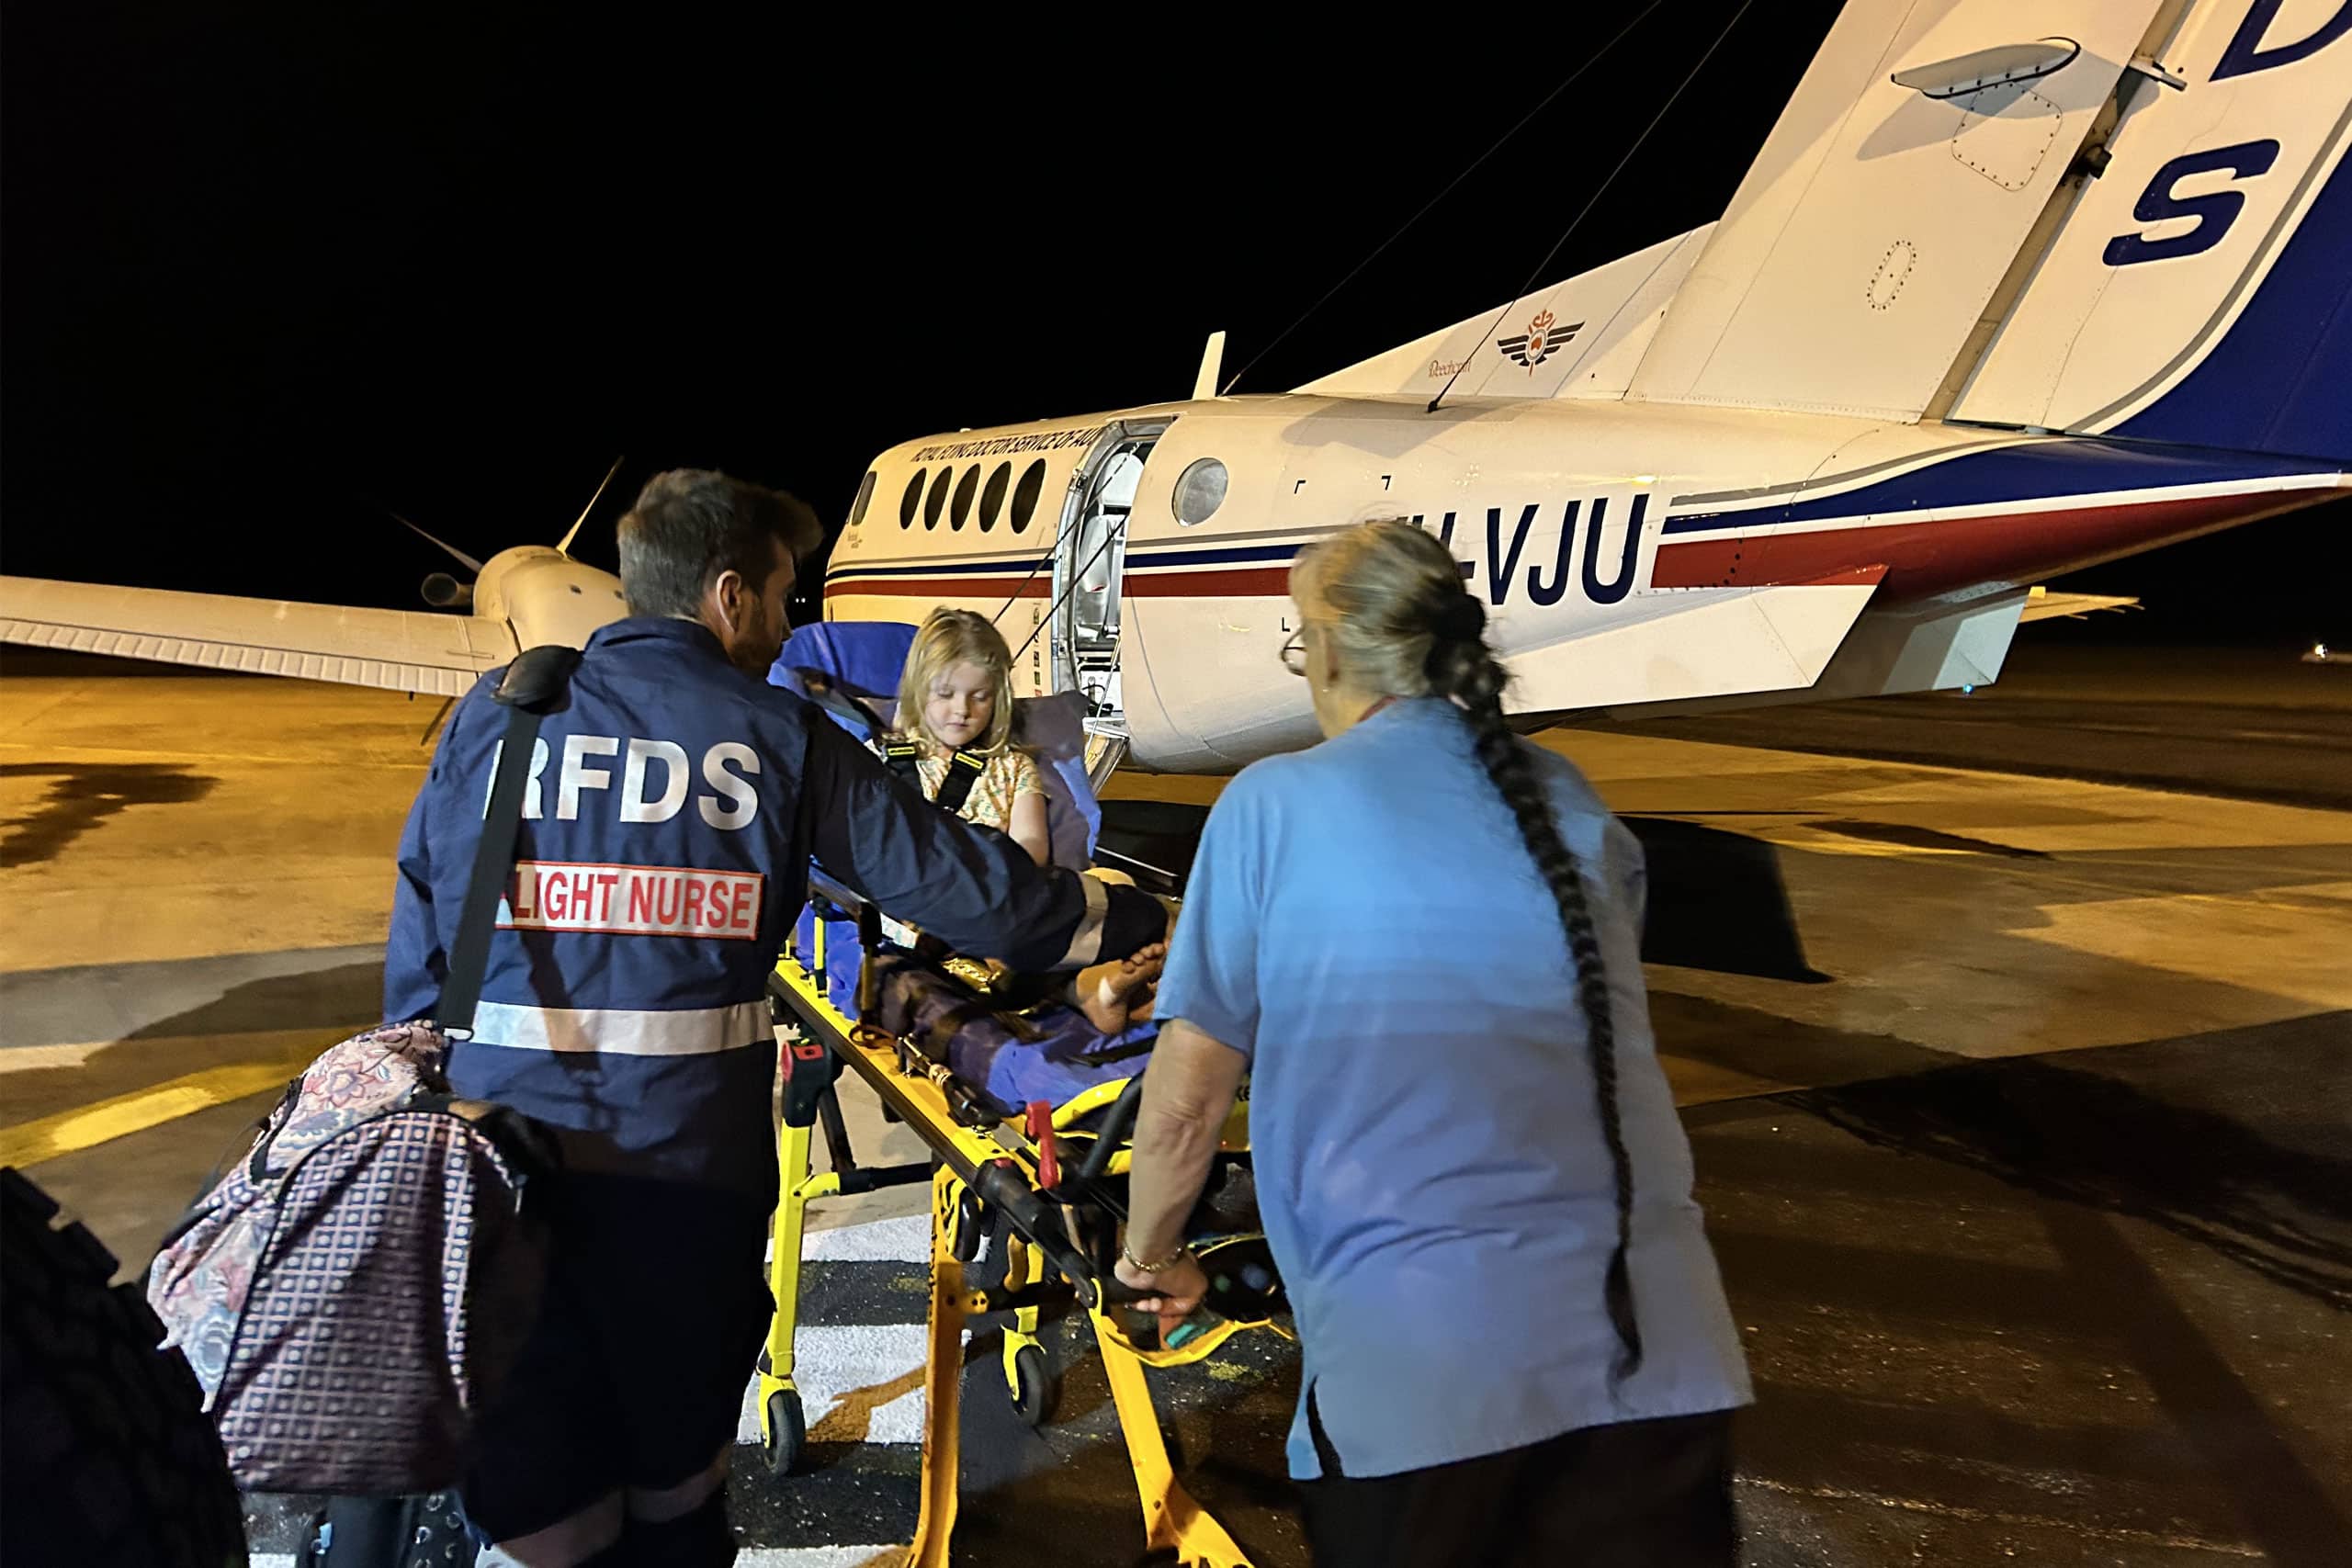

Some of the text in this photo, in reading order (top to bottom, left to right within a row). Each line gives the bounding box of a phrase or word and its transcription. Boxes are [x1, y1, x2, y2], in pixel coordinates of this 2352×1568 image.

[2102, 139, 2280, 266] S
[966, 439, 1012, 457] DOCTOR
[1007, 434, 1065, 454] SERVICE
[1051, 429, 1083, 449] OF
[1068, 426, 1102, 448] AU
[503, 869, 754, 930] LIGHT NURSE
